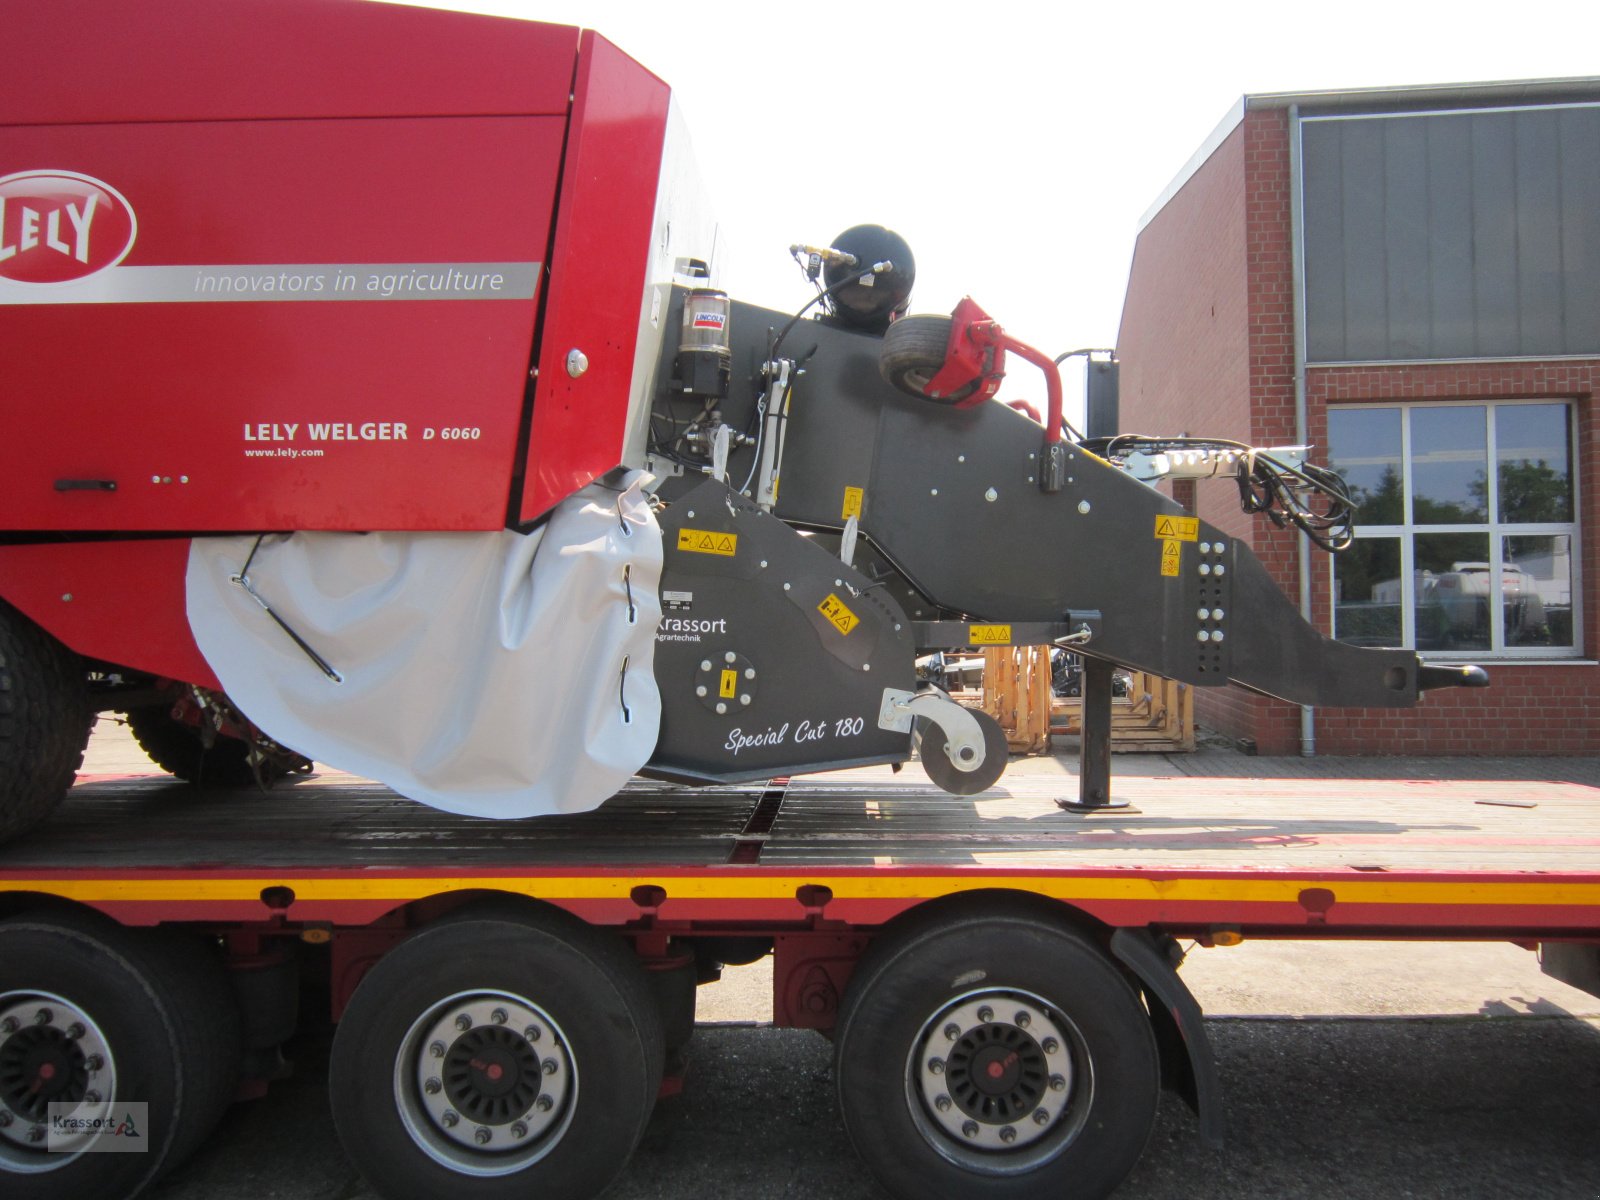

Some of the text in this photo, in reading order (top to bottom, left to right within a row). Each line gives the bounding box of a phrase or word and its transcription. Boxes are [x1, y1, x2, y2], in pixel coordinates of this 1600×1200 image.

[193, 268, 504, 297] innovators in agriculture
[696, 314, 724, 322] LINCOLN
[244, 422, 481, 441] LELY WELGER D 6060
[245, 448, 324, 458] www.lely.com
[724, 716, 864, 756] Special Cut 180
